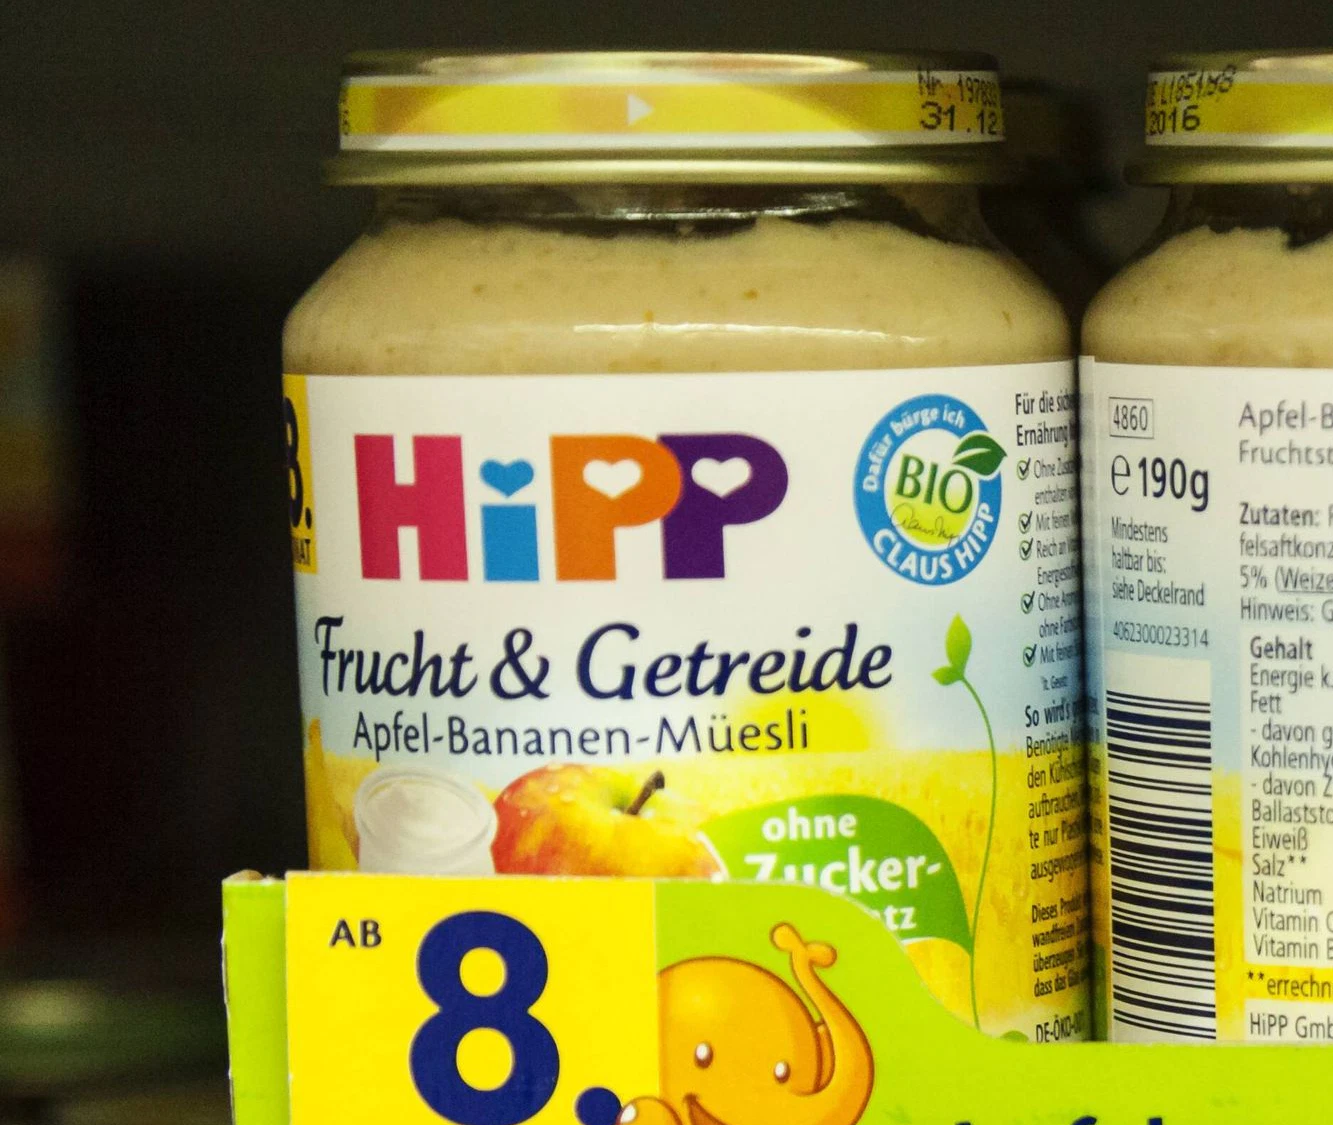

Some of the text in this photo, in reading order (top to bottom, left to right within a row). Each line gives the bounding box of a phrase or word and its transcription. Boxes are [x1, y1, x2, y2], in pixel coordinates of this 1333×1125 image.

[1015, 393, 1037, 415] Für
[1113, 404, 1148, 431] 4860
[863, 404, 967, 493] Dafür bürge ich
[896, 453, 974, 515] BIO
[1138, 456, 1209, 513] 190g
[354, 432, 789, 582] HiPP
[873, 502, 995, 581] CLAUS HIPP
[1112, 516, 1168, 544] Mindestens
[1112, 546, 1167, 575] haltbar bis:
[1112, 579, 1205, 607] siehe Deckelrand
[1240, 597, 1314, 622] Hinweis:
[1113, 620, 1209, 647] 4062300023314
[314, 615, 893, 701] Frucht & Getreide
[1250, 636, 1314, 660] Gehalt
[1250, 663, 1314, 693] Energie
[1250, 691, 1282, 714] Fett
[353, 708, 809, 763] Apfel-Bananen-Müesli
[1262, 722, 1315, 743] davon
[762, 806, 858, 842] ohne
[1252, 826, 1309, 850] Eiweiß
[1252, 880, 1323, 906] Natrium
[329, 918, 383, 949] AB
[1252, 907, 1319, 932] Vitamin
